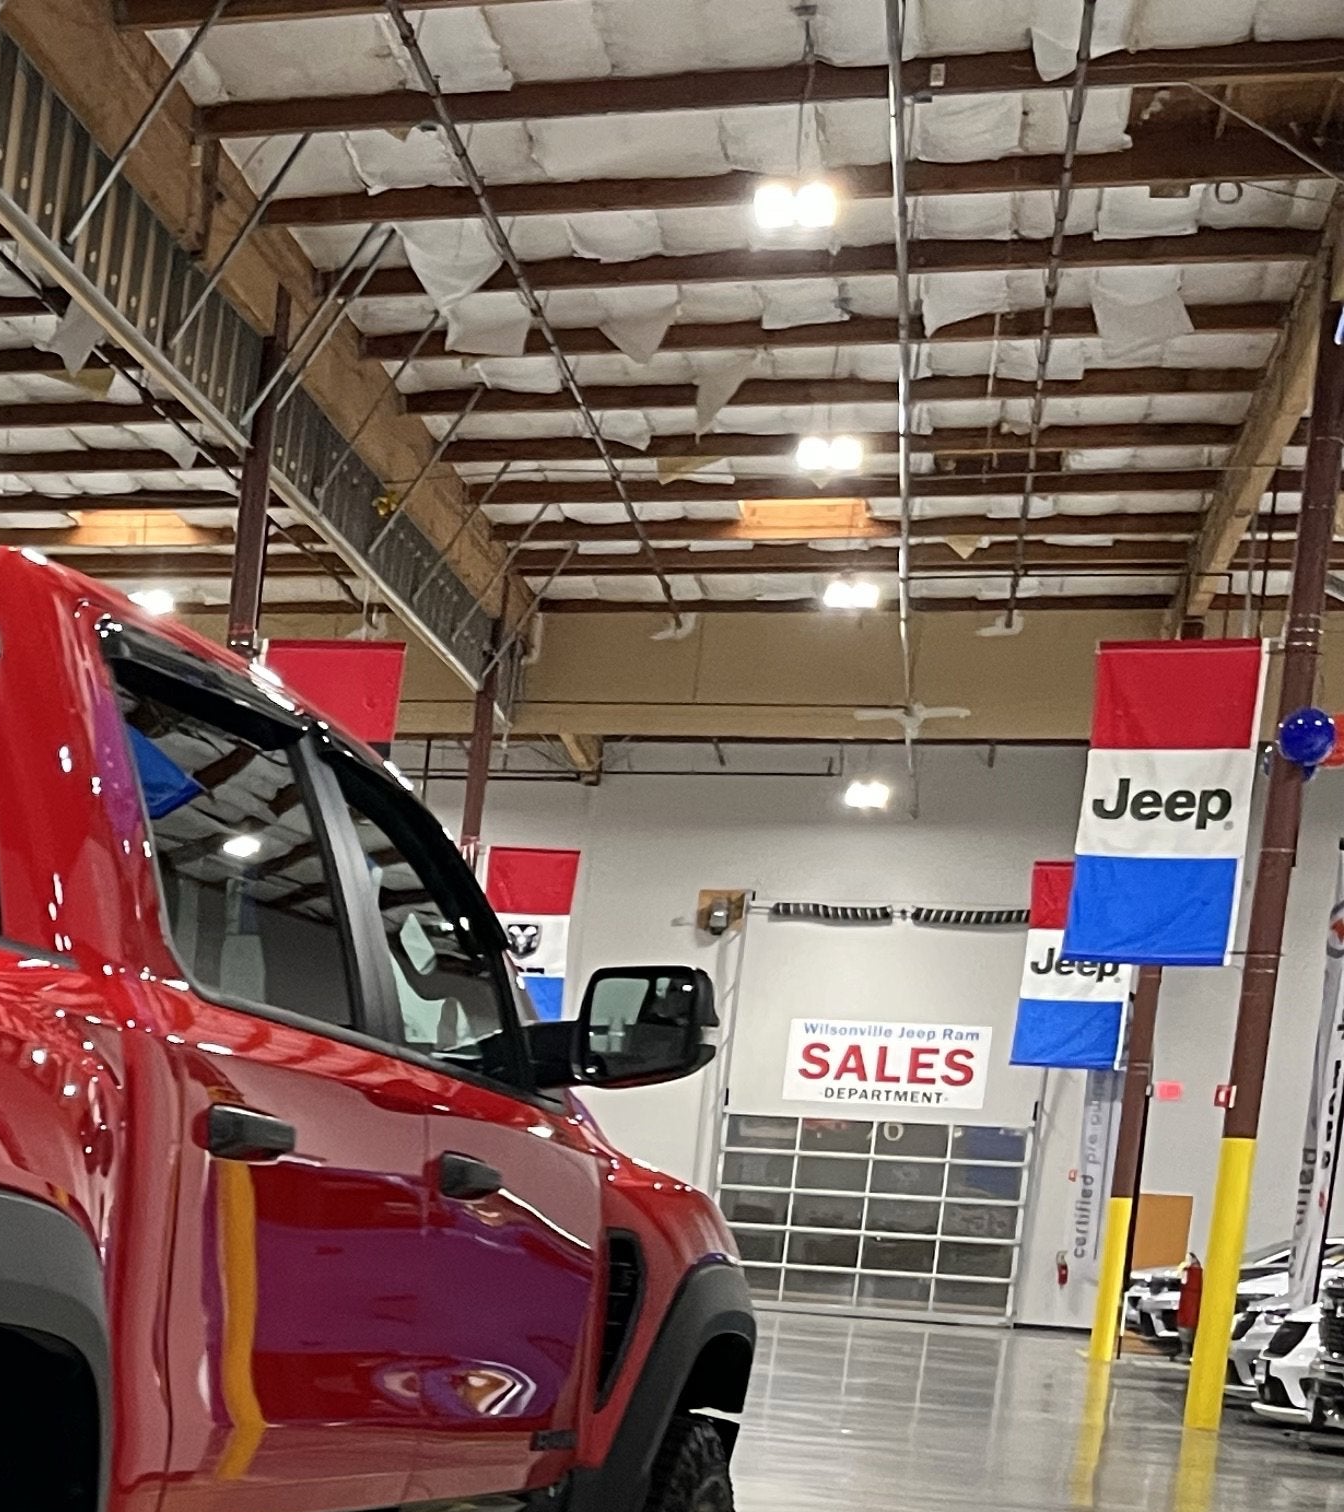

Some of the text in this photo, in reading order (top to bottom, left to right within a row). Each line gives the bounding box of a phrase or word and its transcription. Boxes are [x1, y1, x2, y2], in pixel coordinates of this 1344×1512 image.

[1092, 778, 1232, 830] Jeep
[804, 1022, 980, 1042] Wilsonville Jeep Ram
[798, 1042, 975, 1087] SALES
[824, 1087, 943, 1104] DEPARTMENT
